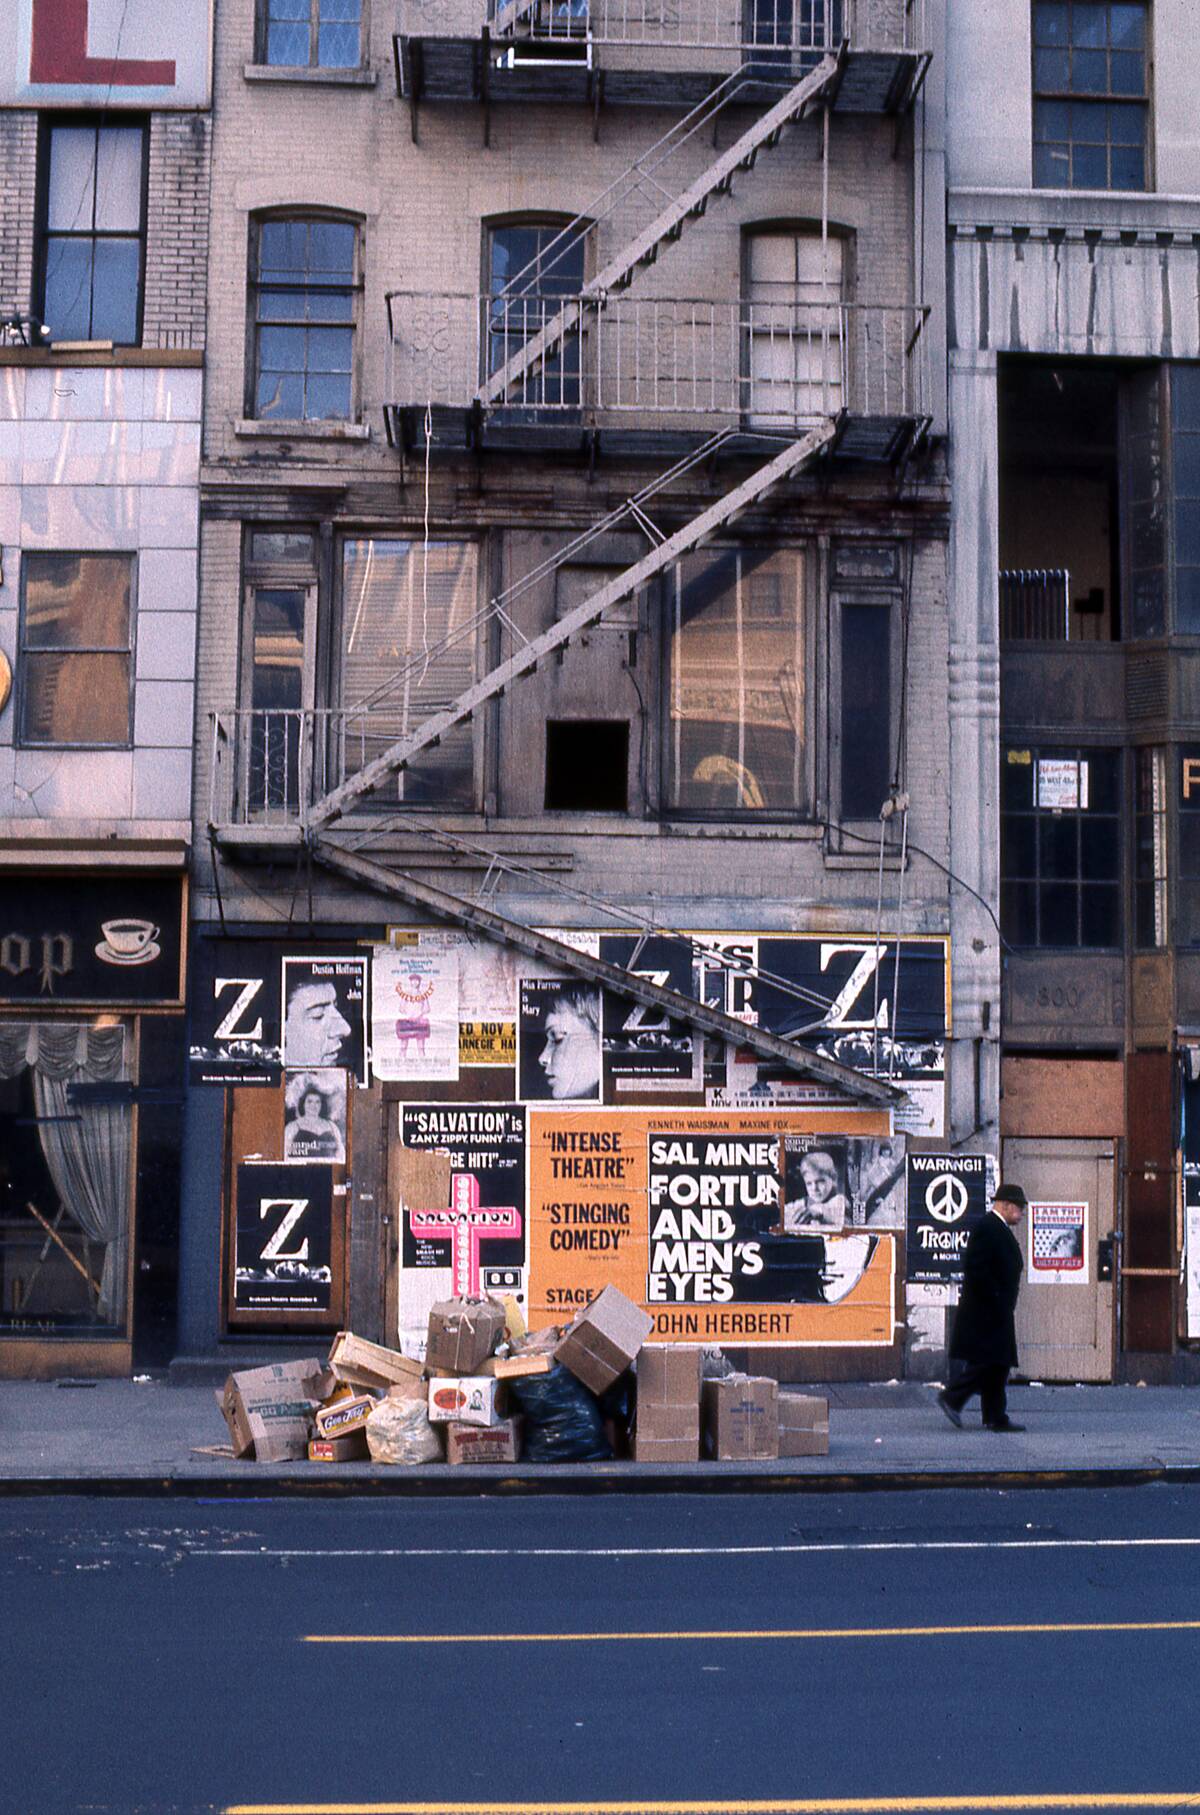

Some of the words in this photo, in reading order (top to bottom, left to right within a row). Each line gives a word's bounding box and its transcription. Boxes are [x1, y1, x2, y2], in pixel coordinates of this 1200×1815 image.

[311, 963, 335, 975] Dustin
[336, 964, 363, 975] Hoffman
[355, 978, 363, 987] is
[522, 982, 536, 990] Mia
[820, 943, 888, 1029] Z
[522, 992, 529, 1002] is
[214, 978, 264, 1040] Z
[522, 1005, 540, 1016] Mary
[482, 1023, 504, 1035] NOV
[511, 1115, 523, 1132] is
[648, 1121, 684, 1129] KENNETH
[739, 1121, 770, 1129] MAXINE
[410, 1134, 439, 1144] ZANY,
[440, 1134, 468, 1144] ZIPPY,
[470, 1134, 503, 1143] FUNNY
[784, 1136, 816, 1145] conrad
[651, 1141, 699, 1165] SAL
[785, 1144, 808, 1152] ward
[260, 1199, 309, 1260] Z
[651, 1208, 736, 1240] AND
[652, 1241, 764, 1275] MEN'S
[932, 1253, 938, 1261] A
[649, 1273, 734, 1302] EYES
[546, 1288, 594, 1304] STAGE
[705, 1313, 793, 1334] HERBERT
